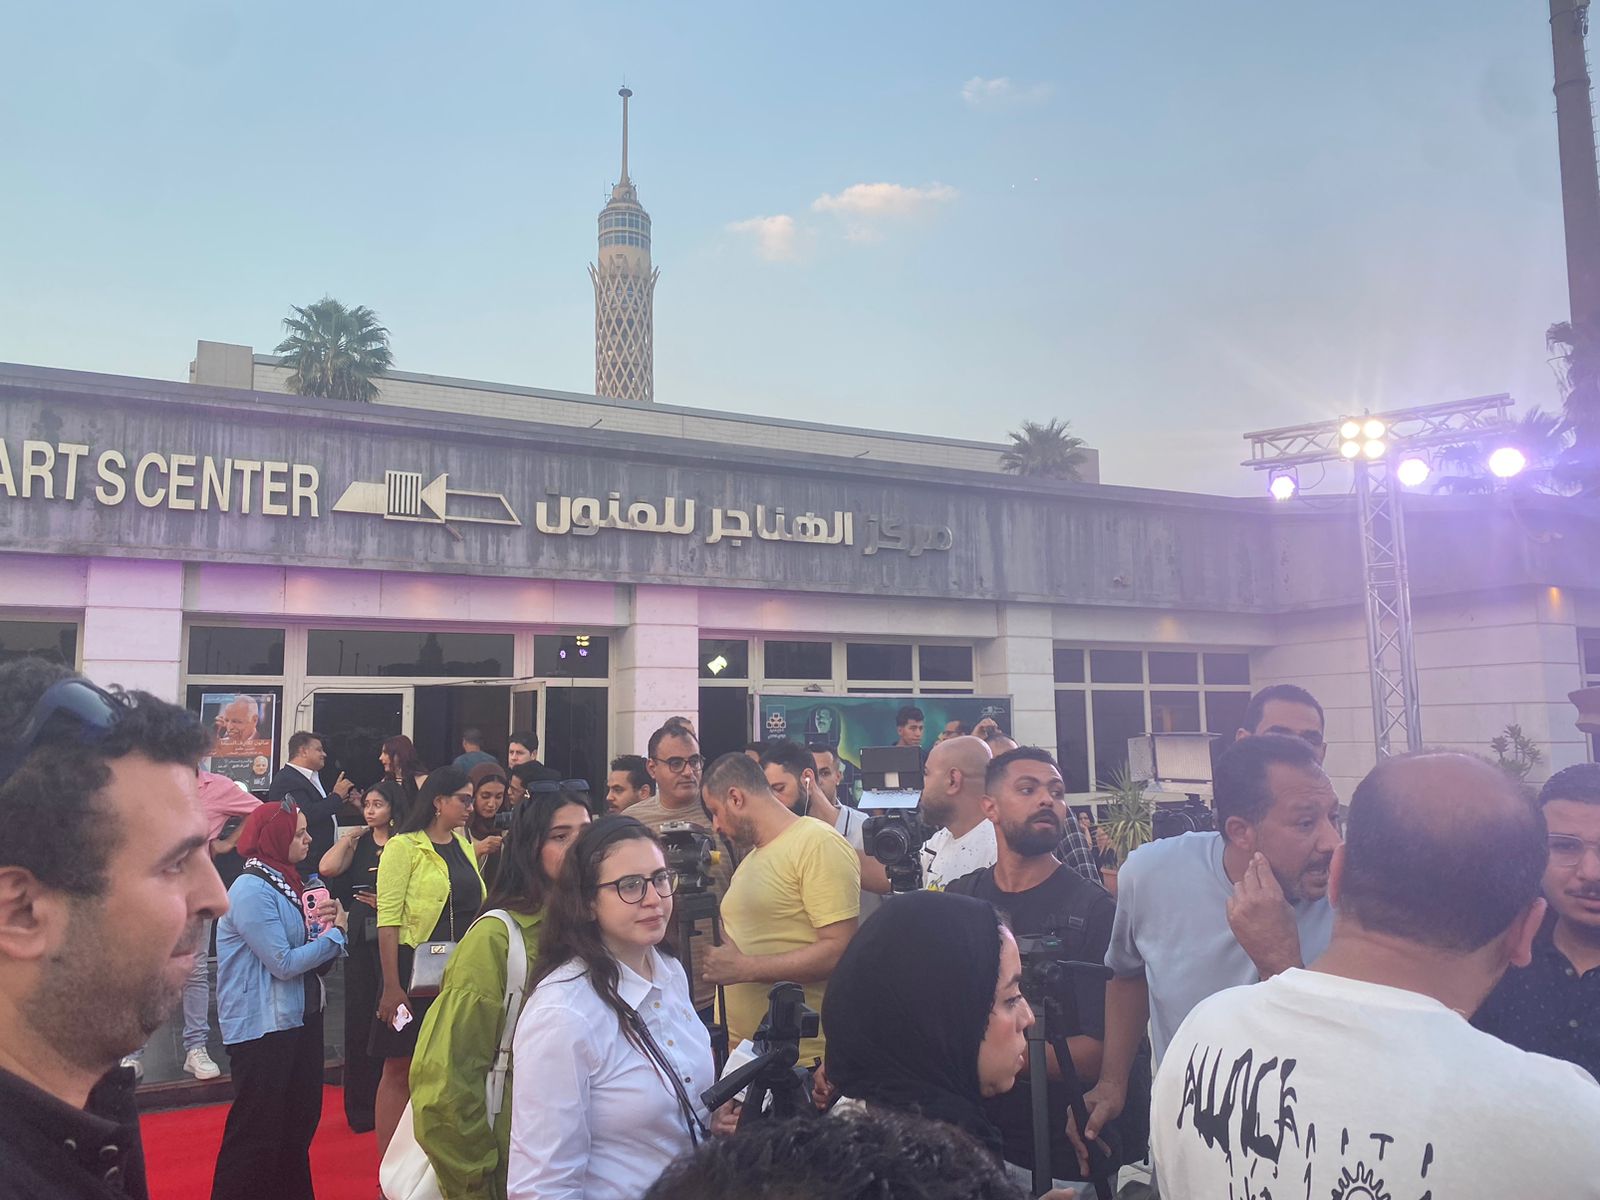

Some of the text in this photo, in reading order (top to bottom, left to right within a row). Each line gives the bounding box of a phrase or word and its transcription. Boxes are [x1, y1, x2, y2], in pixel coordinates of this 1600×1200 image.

[134, 452, 320, 518] CENTER
[535, 486, 954, 557] مركز الهناجر للفنون
